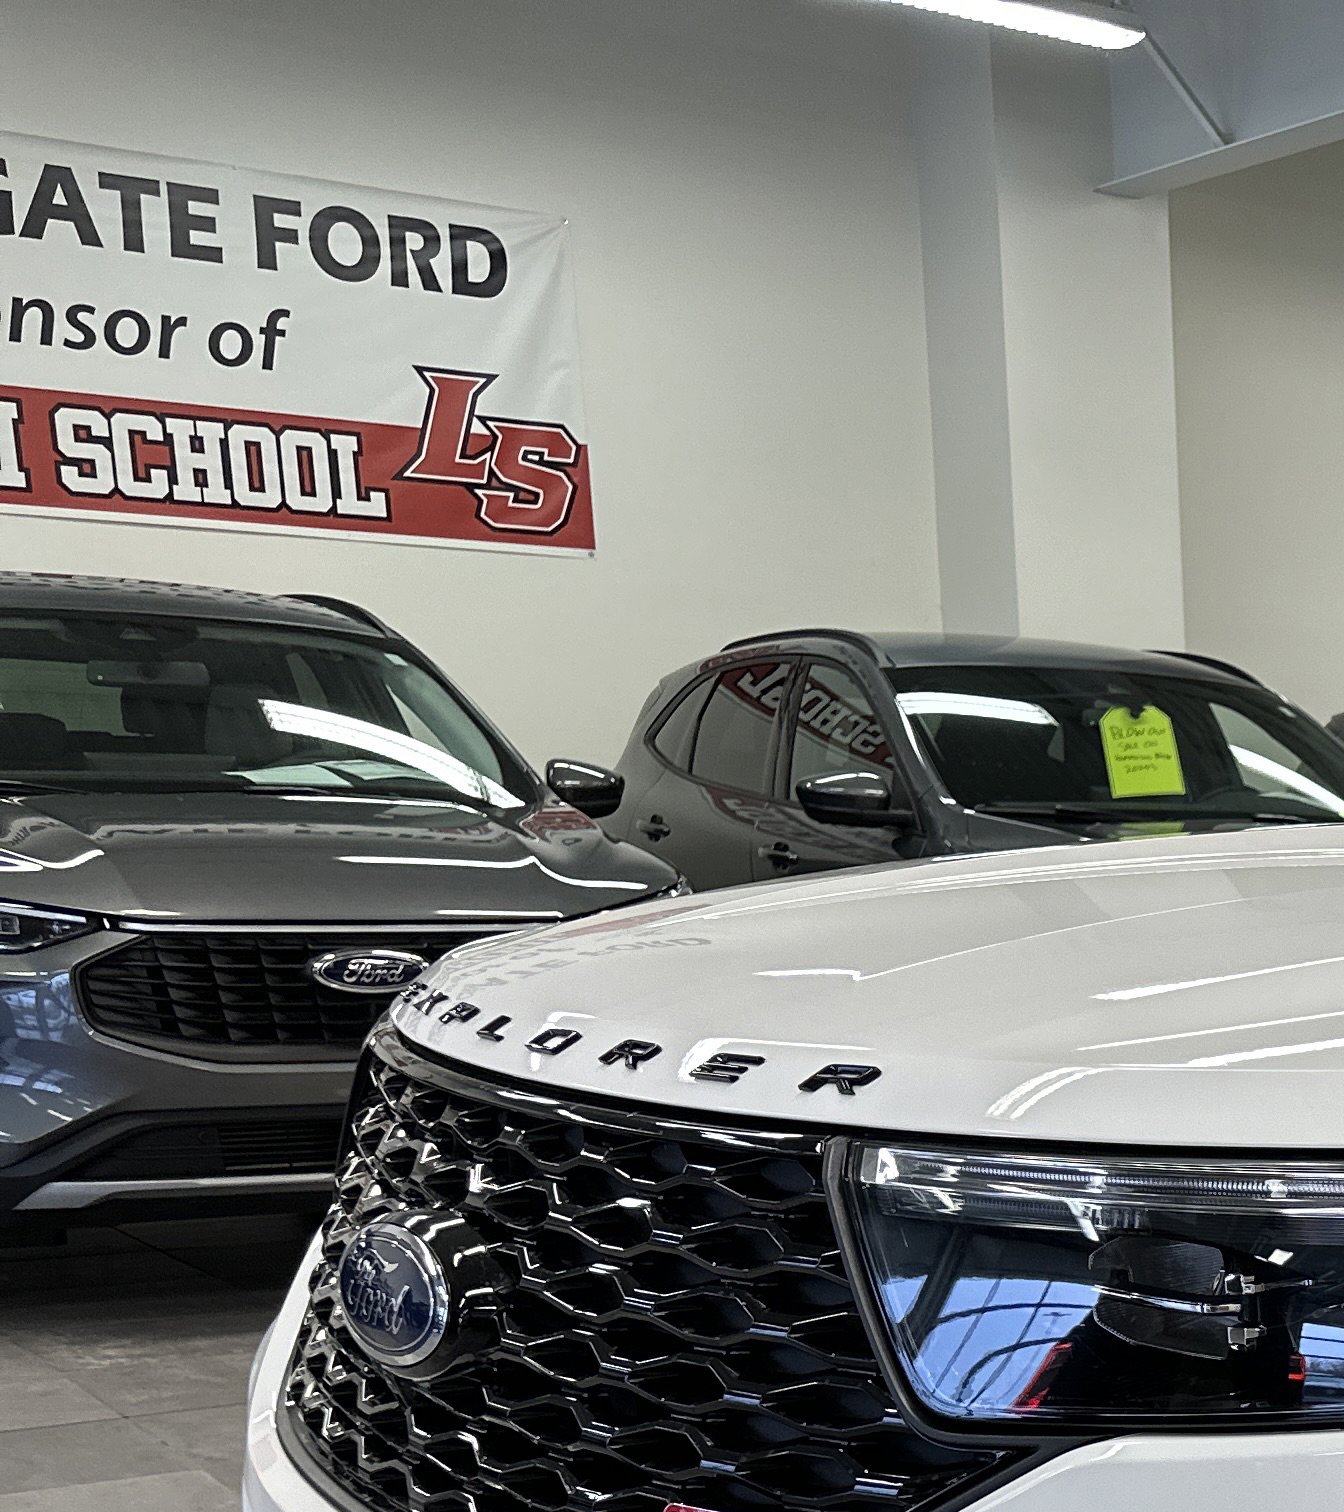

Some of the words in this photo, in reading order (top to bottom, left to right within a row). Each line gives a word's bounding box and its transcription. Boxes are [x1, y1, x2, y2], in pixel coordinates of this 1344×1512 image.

[252, 193, 508, 299] FORD
[0, 296, 188, 360] nsor
[207, 308, 291, 371] of
[50, 402, 392, 523] SCHOOL
[391, 365, 587, 538] LS
[342, 958, 405, 984] Ford
[400, 981, 883, 1096] EXPLORER
